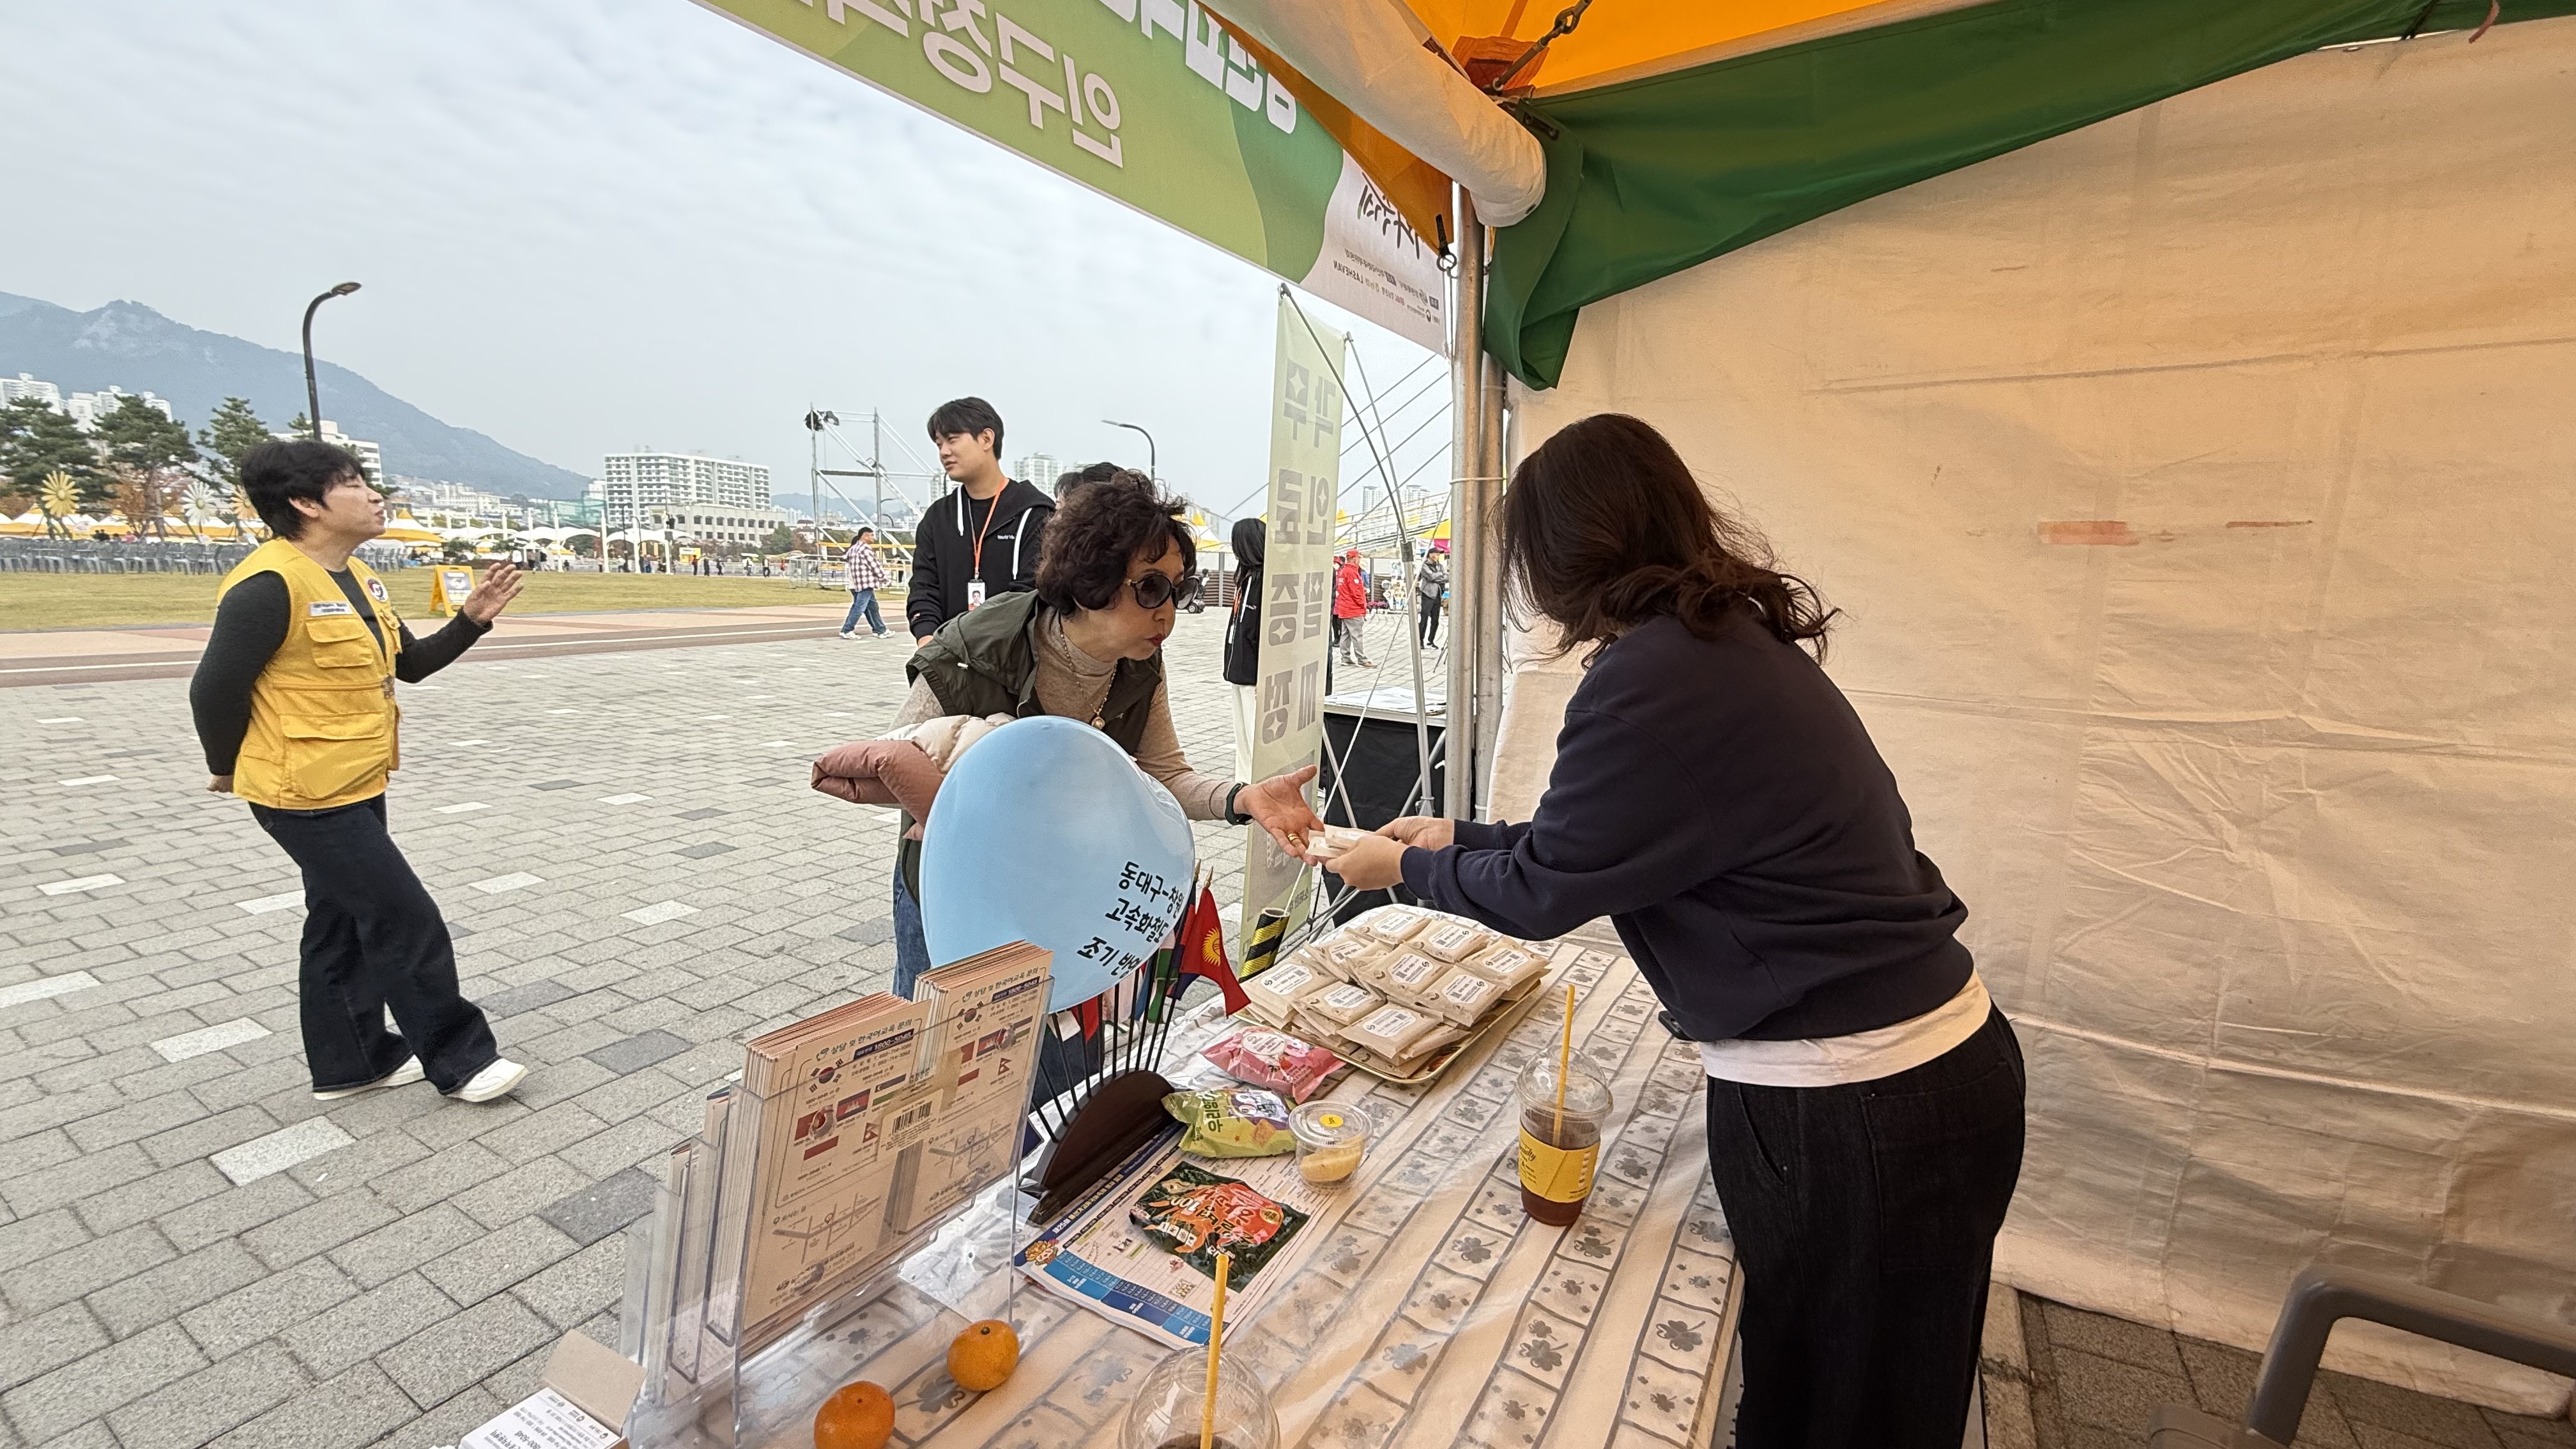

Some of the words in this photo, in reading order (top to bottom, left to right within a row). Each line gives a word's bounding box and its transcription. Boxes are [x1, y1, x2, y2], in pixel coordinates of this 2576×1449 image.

[1105, 898, 1170, 944] 고속화철도
[1077, 936, 1120, 967] 조기
[831, 1041, 847, 1054] 상담
[857, 1023, 896, 1045] 한국어교육
[896, 1017, 913, 1031] 문의
